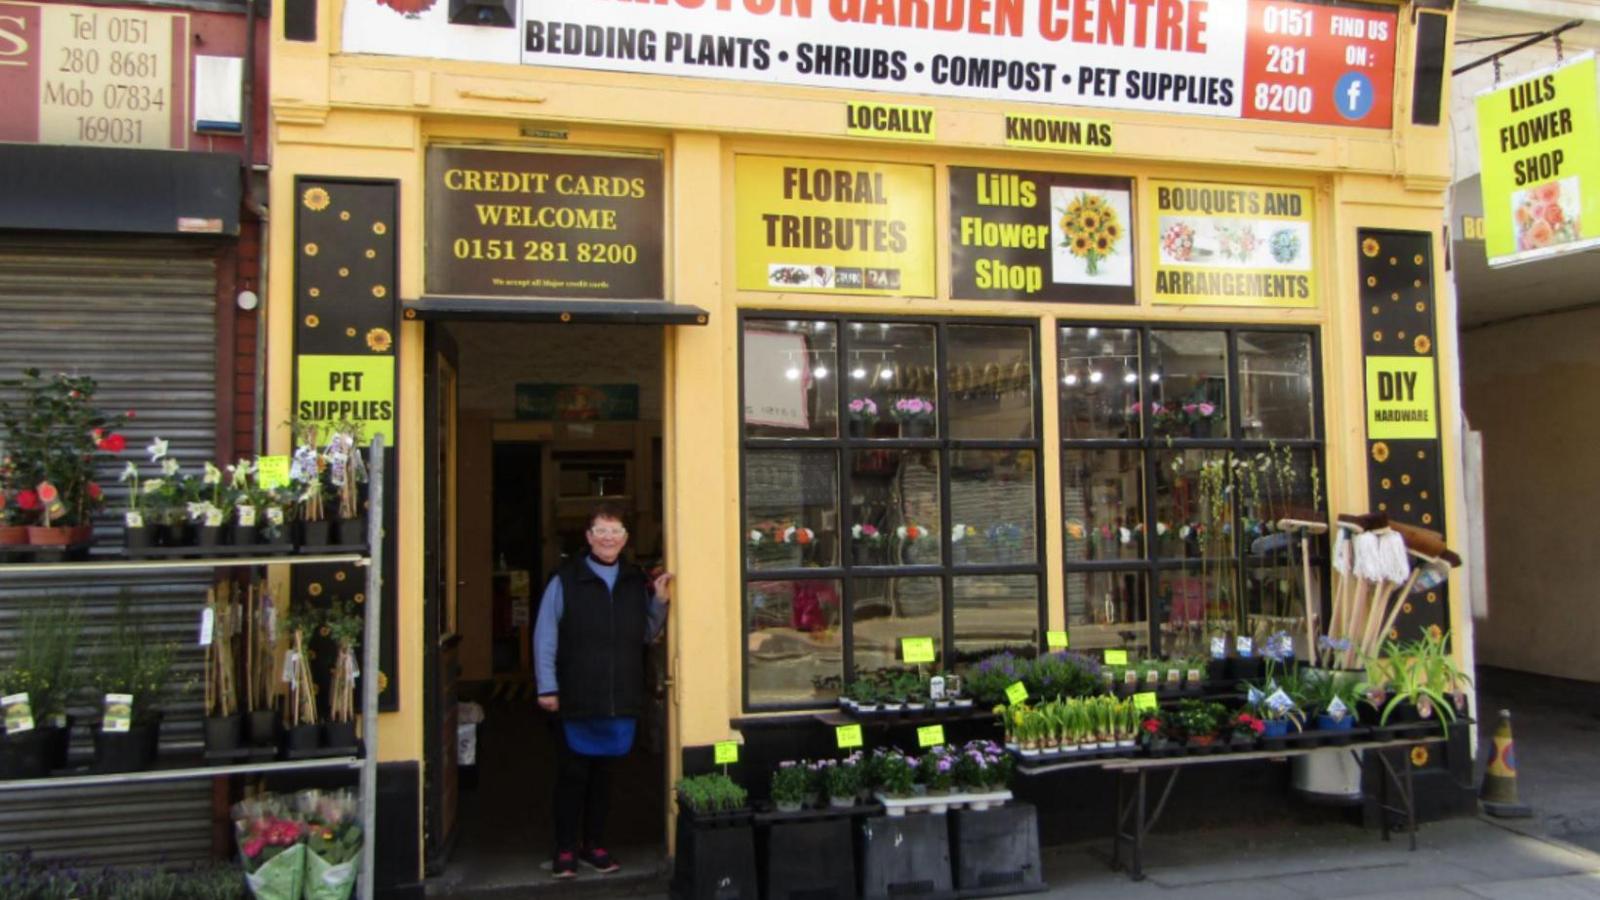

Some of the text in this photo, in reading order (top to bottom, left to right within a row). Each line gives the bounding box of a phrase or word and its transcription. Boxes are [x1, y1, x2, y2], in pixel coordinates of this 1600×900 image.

[71, 13, 148, 44] Tel 0151
[1038, 0, 1208, 54] CENTRE
[1264, 6, 1312, 37] 0151
[1331, 15, 1388, 41] FIND US
[60, 47, 157, 78] 280 8681
[525, 19, 1234, 107] BEDDING PLANTS SHRUBS COMPOST PET SUPPLIES
[1266, 44, 1305, 75] 281
[43, 80, 164, 111] Mob 07834
[1255, 83, 1312, 114] 8200
[1509, 75, 1556, 112] LILLS
[78, 116, 142, 143] 169031
[847, 104, 1112, 148] LOCALLY KNOWN AS
[1500, 108, 1573, 153] FLOWER
[1514, 149, 1564, 186] SHOP
[444, 169, 645, 198] CREDIT CARDS
[783, 167, 888, 204] FLORAL
[977, 172, 1036, 208] Lills
[475, 204, 617, 230] WELCOME
[1158, 187, 1302, 217] BOUQUETS AND
[762, 214, 907, 253] TRIBUTES
[961, 217, 1049, 249] Flower
[454, 238, 637, 264] 0151 281 8200
[976, 258, 1042, 292] Shop
[1155, 271, 1309, 299] ARRANGEMENTS
[329, 371, 364, 391] PET
[1377, 371, 1416, 401] DIY
[300, 401, 392, 421] SUPPLIES
[1374, 409, 1429, 422] HARDWARE
